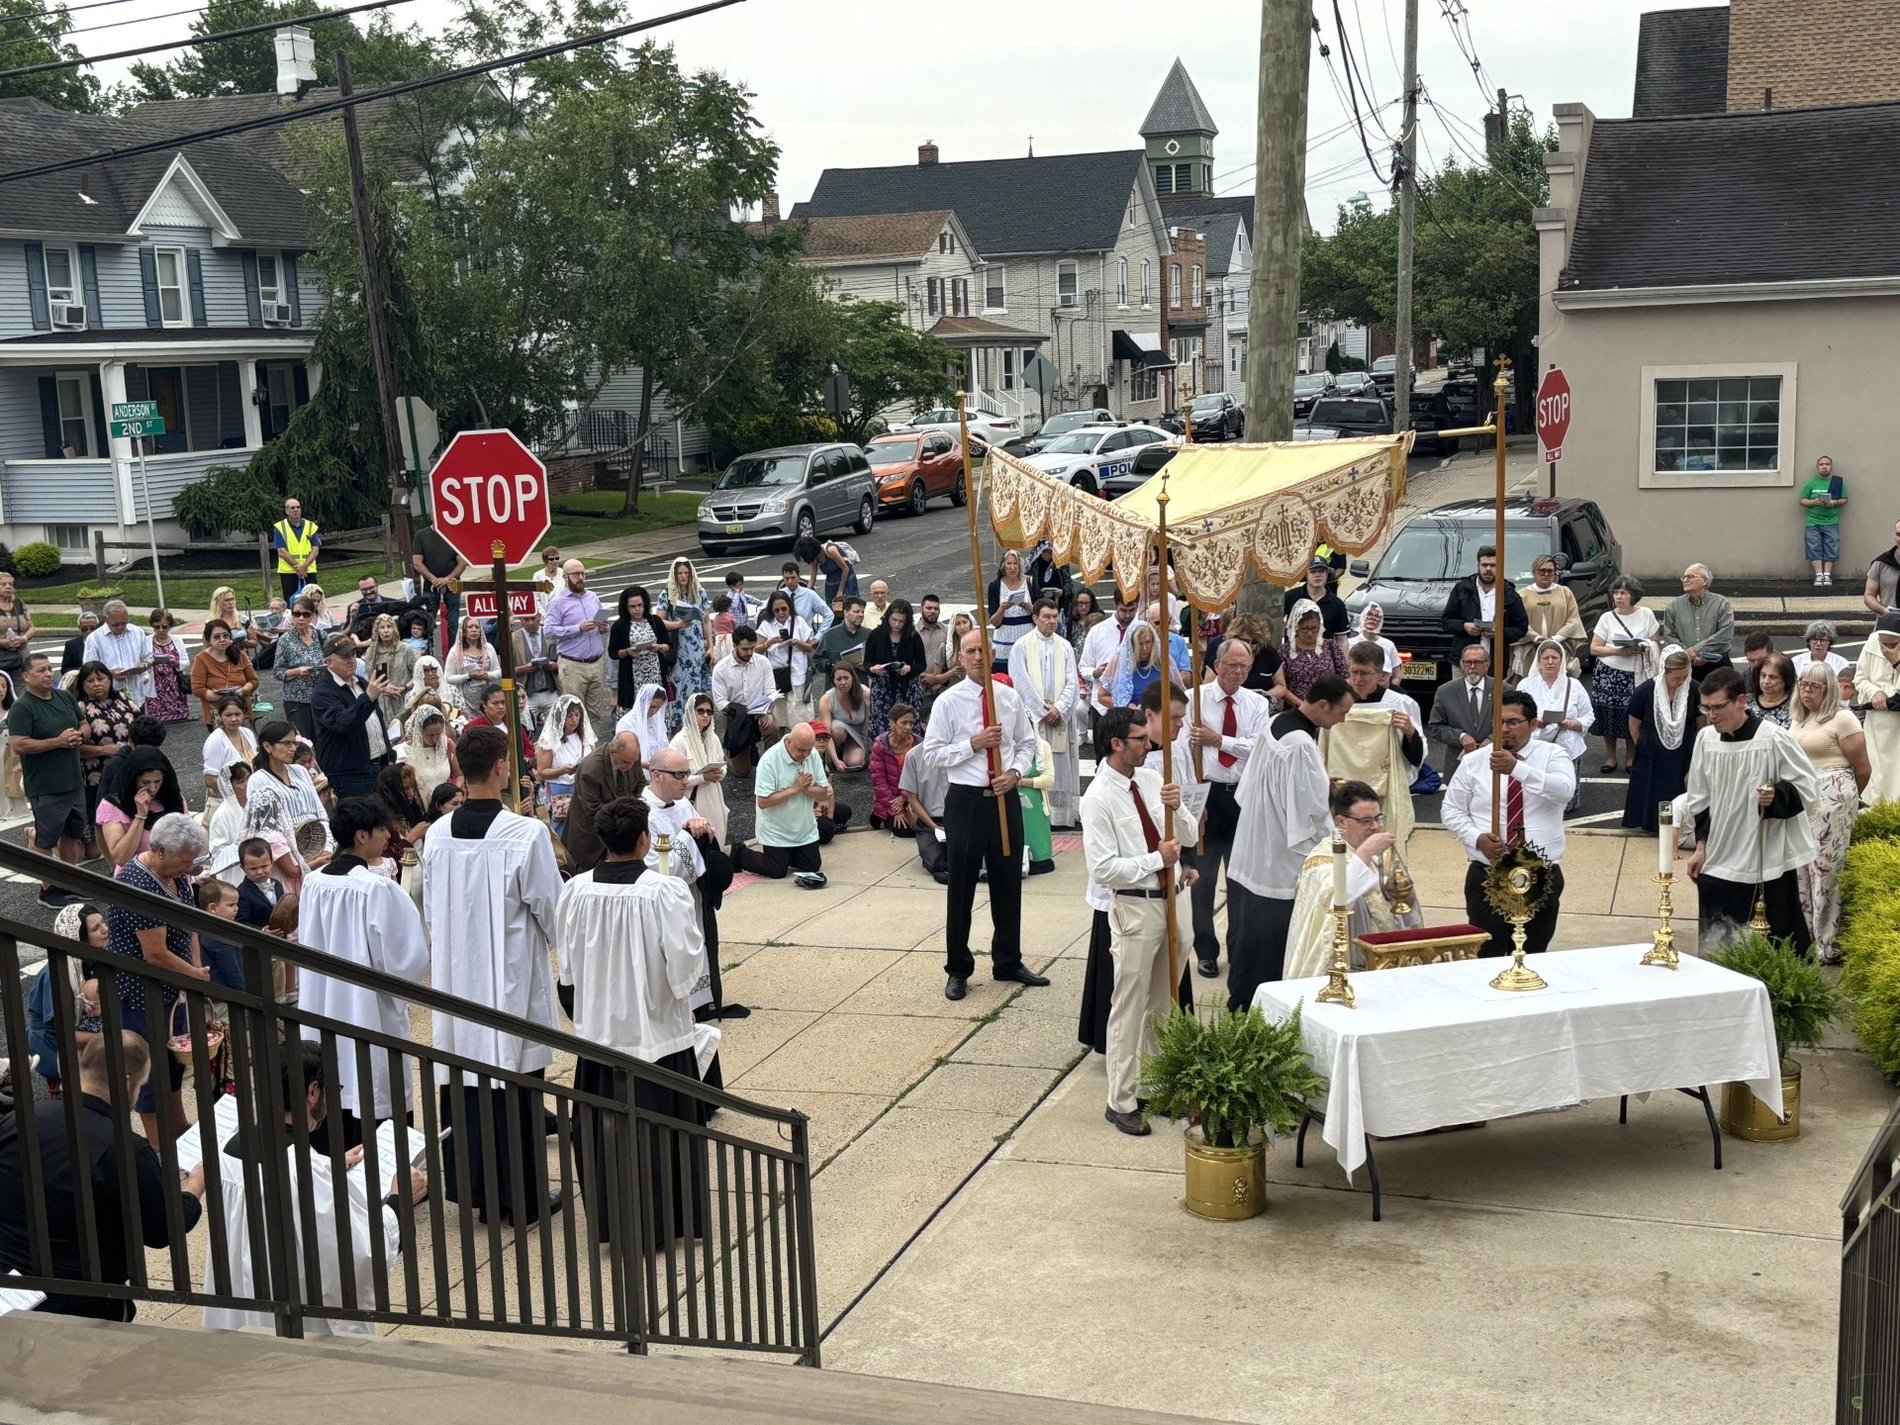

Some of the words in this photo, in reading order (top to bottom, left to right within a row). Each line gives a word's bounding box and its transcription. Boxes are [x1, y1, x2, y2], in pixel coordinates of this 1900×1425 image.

[114, 404, 150, 418] ANDERSON
[1540, 393, 1568, 428] STOP
[121, 422, 143, 435] 2ND
[146, 420, 153, 428] ST
[441, 474, 538, 526] STOP
[474, 597, 497, 613] ALL
[1403, 666, 1434, 676] 30322MG
